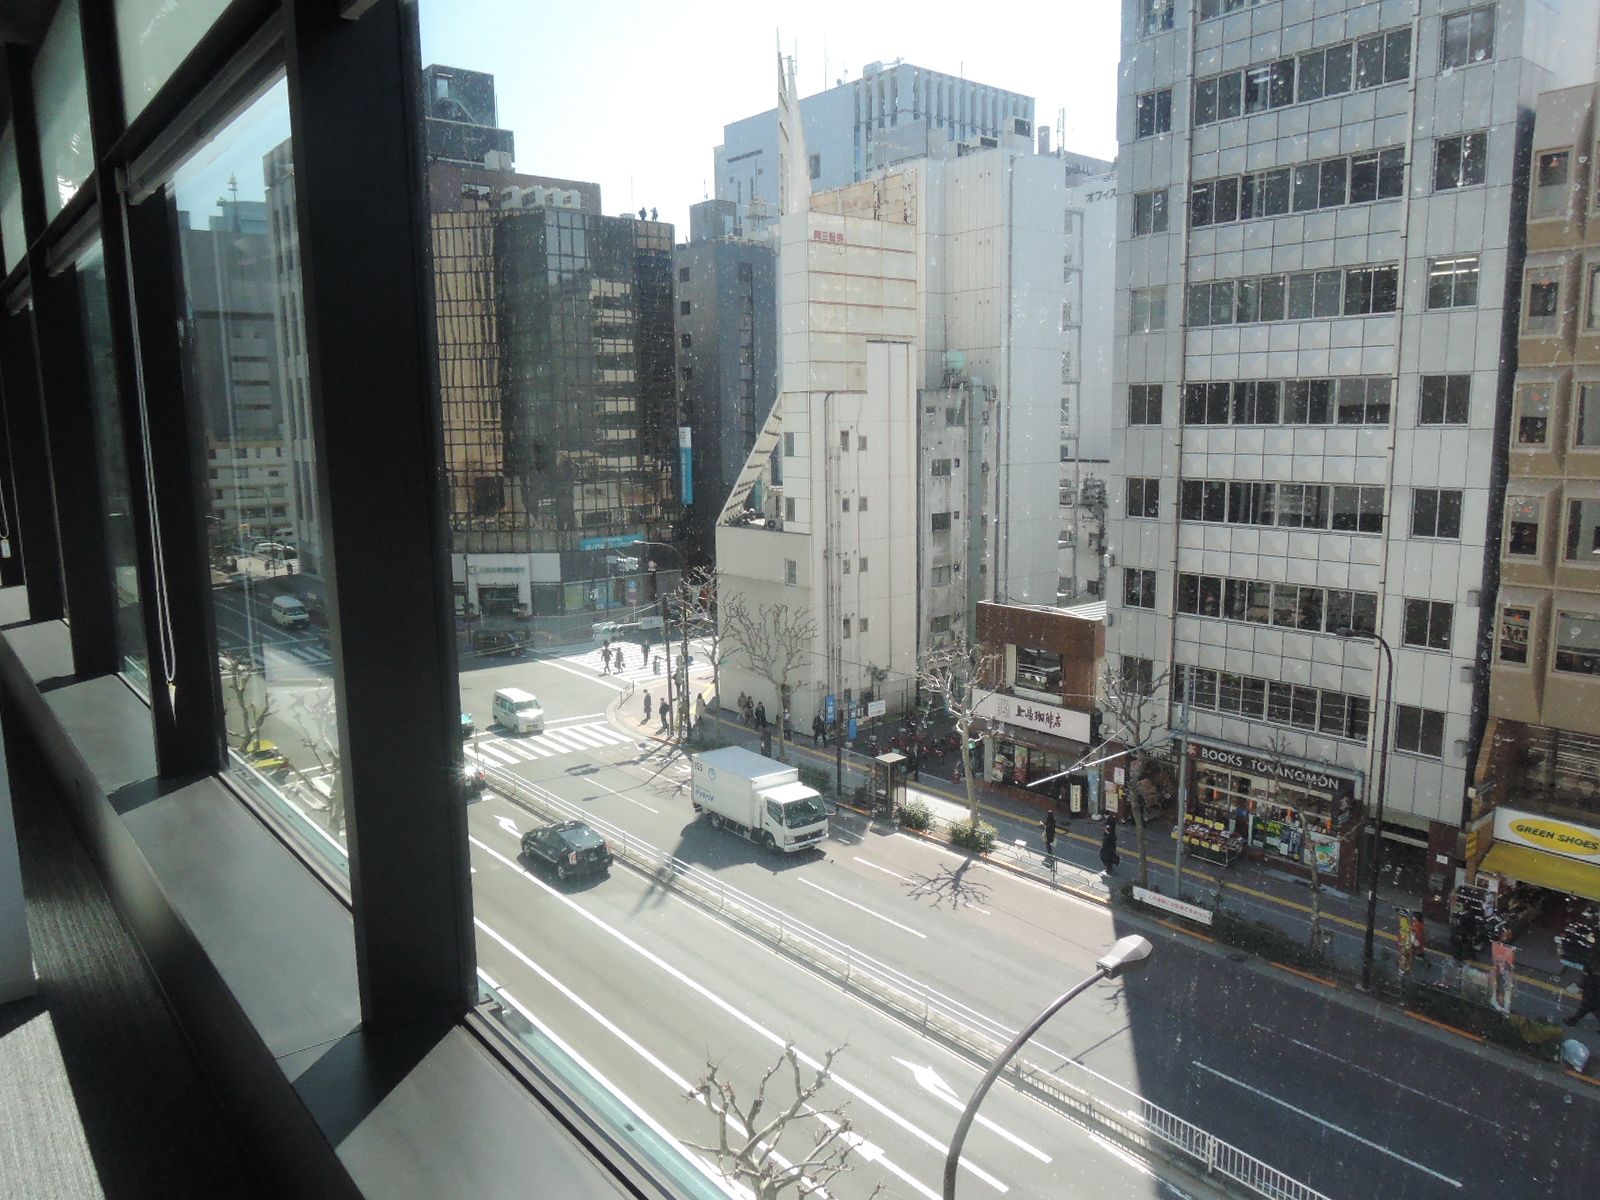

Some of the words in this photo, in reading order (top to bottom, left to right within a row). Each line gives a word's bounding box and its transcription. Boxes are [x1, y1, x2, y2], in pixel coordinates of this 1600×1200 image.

[1201, 748, 1243, 767] BOOKS
[1516, 824, 1555, 840] GREEN
[1557, 834, 1599, 850] SHOES
